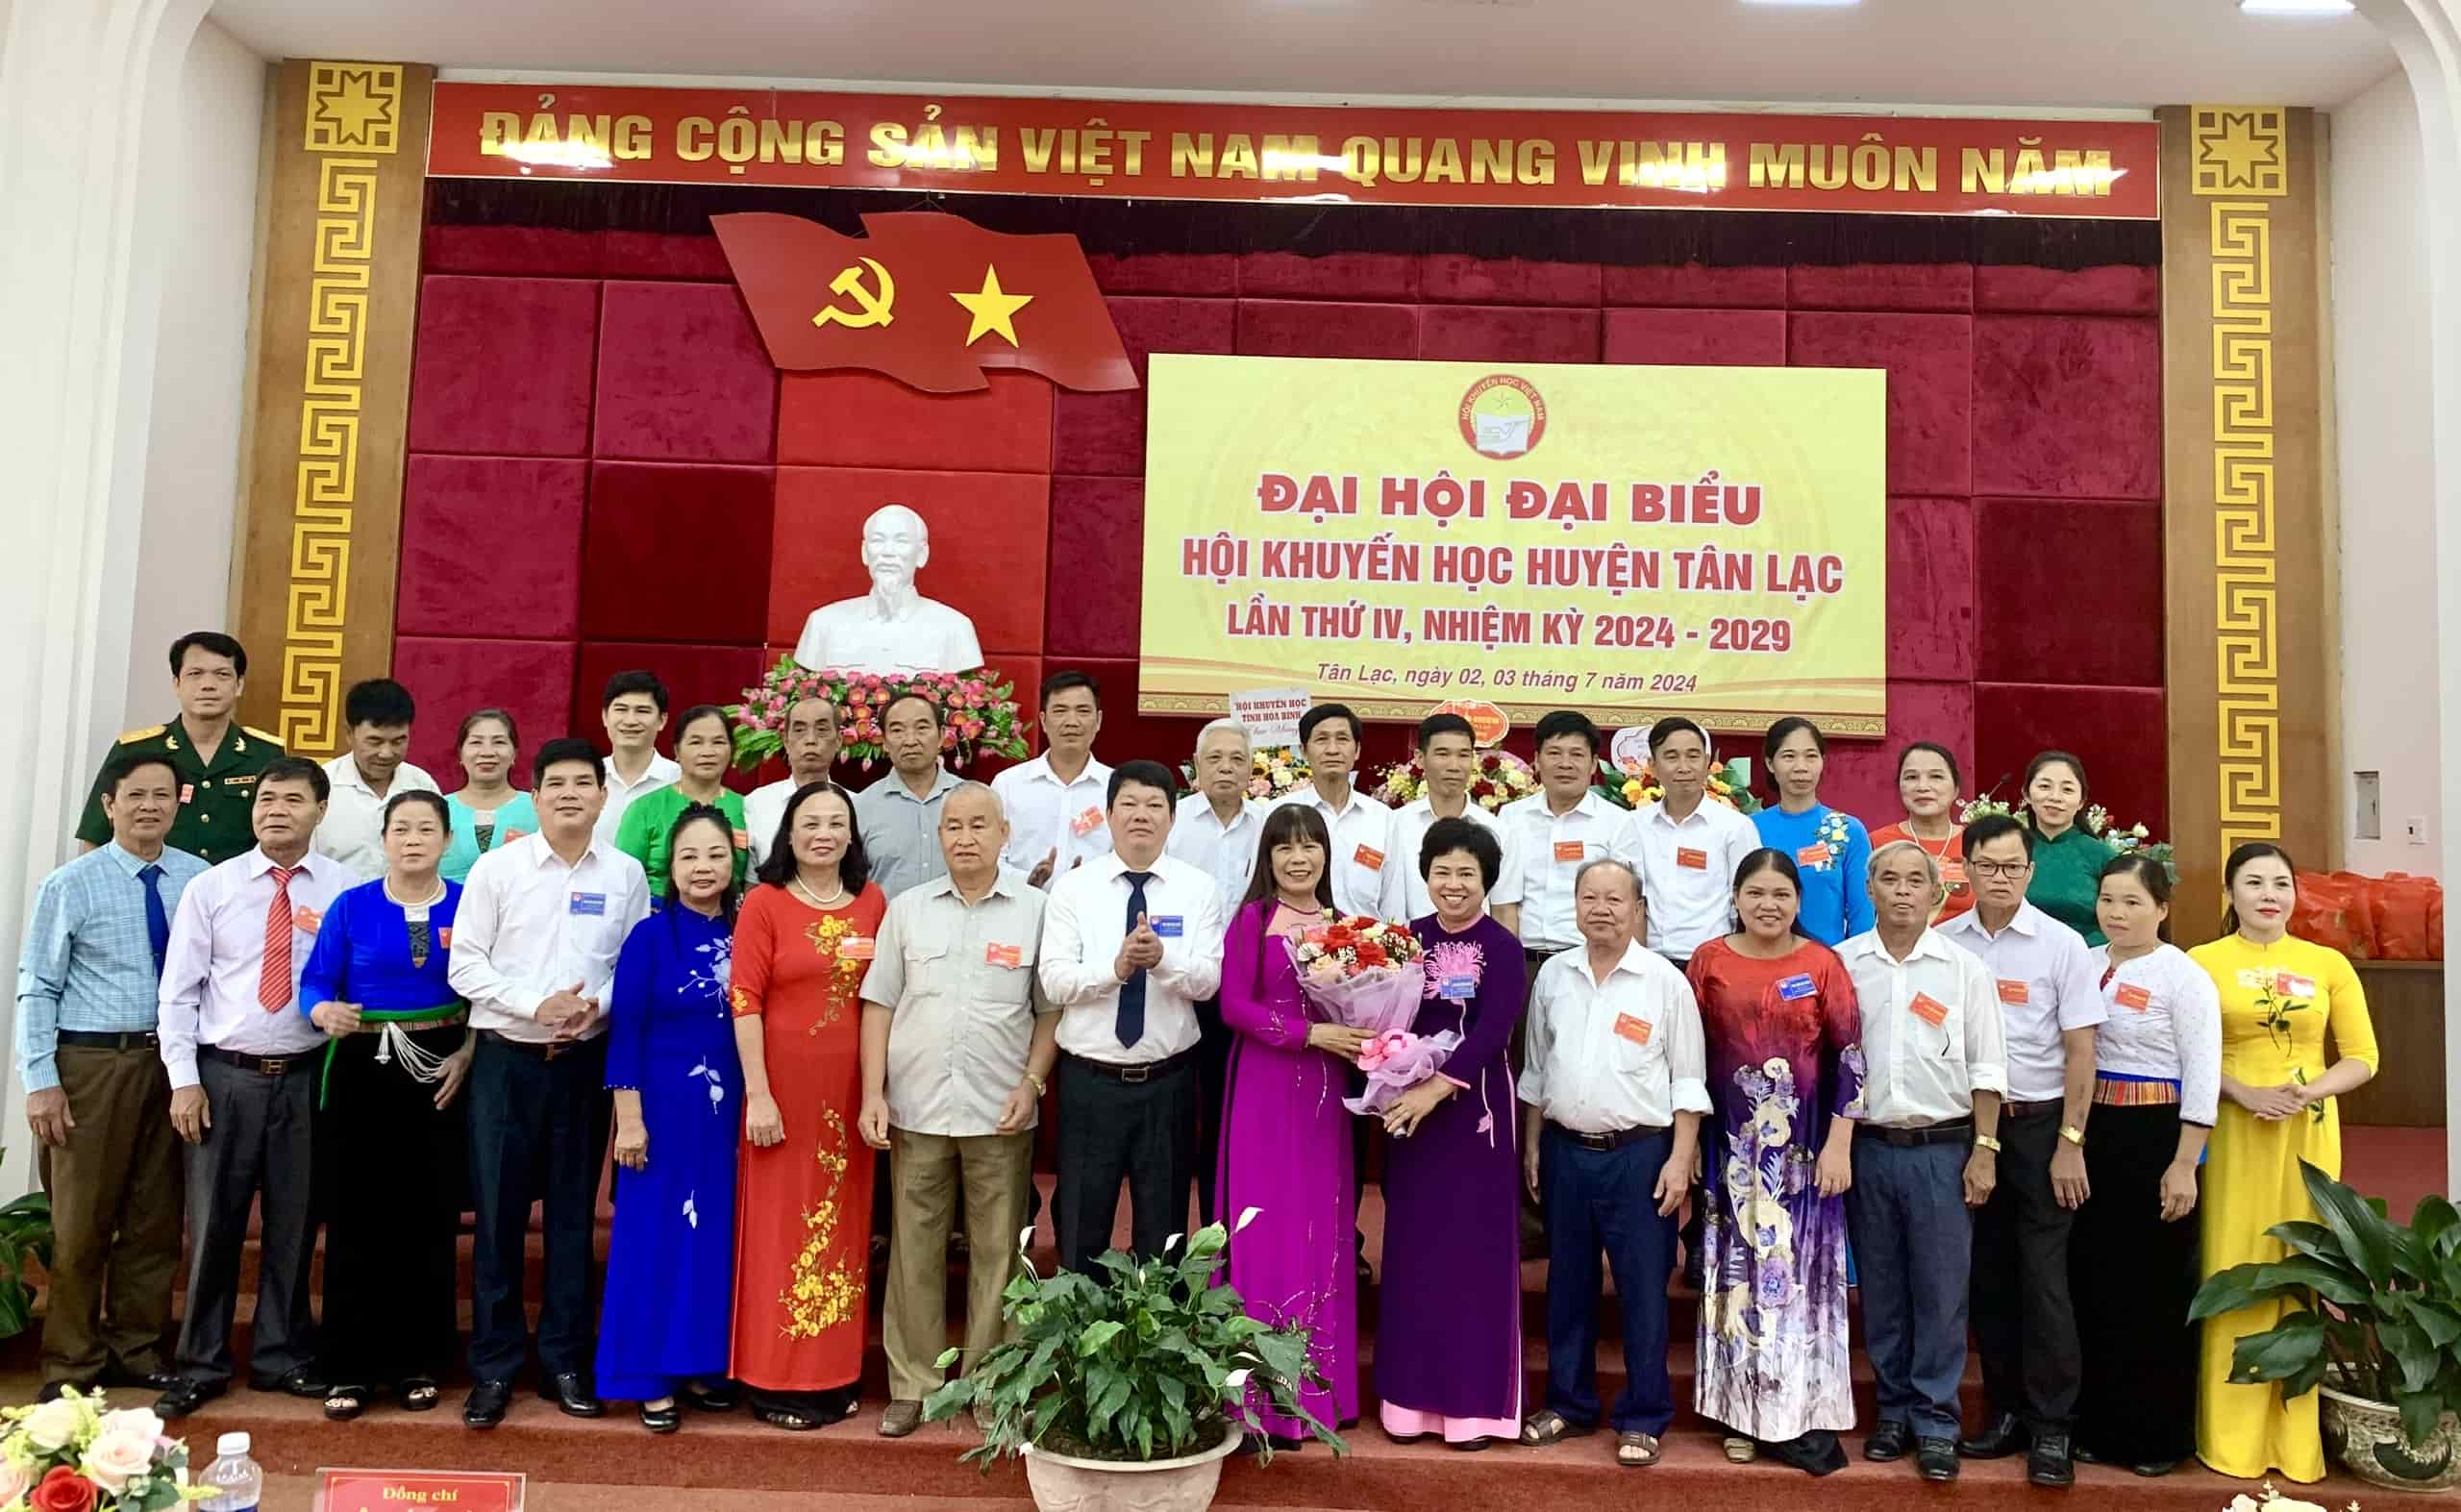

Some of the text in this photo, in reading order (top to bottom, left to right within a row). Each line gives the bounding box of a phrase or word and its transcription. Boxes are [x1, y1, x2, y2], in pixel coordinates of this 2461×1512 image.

[480, 93, 2111, 196] ĐẢNG CỘNG SẢN VIỆT NAM QUANG VINH MUÔN NĂM
[1257, 470, 1761, 531] ĐẠI HỘI ĐẠI BIỂU
[1183, 531, 1844, 602] HỘI KHUYẾN HỌC HUYỆN TÂN LẠC
[1228, 592, 1291, 636] LẦN
[1301, 600, 1366, 638] THỨ
[1373, 608, 1411, 644] IV,
[1423, 605, 1531, 651] NHIỆM
[1543, 607, 1584, 645] KỲ
[1594, 615, 1675, 649] 2024
[1709, 618, 1791, 652] 2029
[1318, 663, 1699, 693] Tân Lạc, ngày 02, 03 tháng 7 năm 2024
[383, 1485, 459, 1503] Đồng chí
